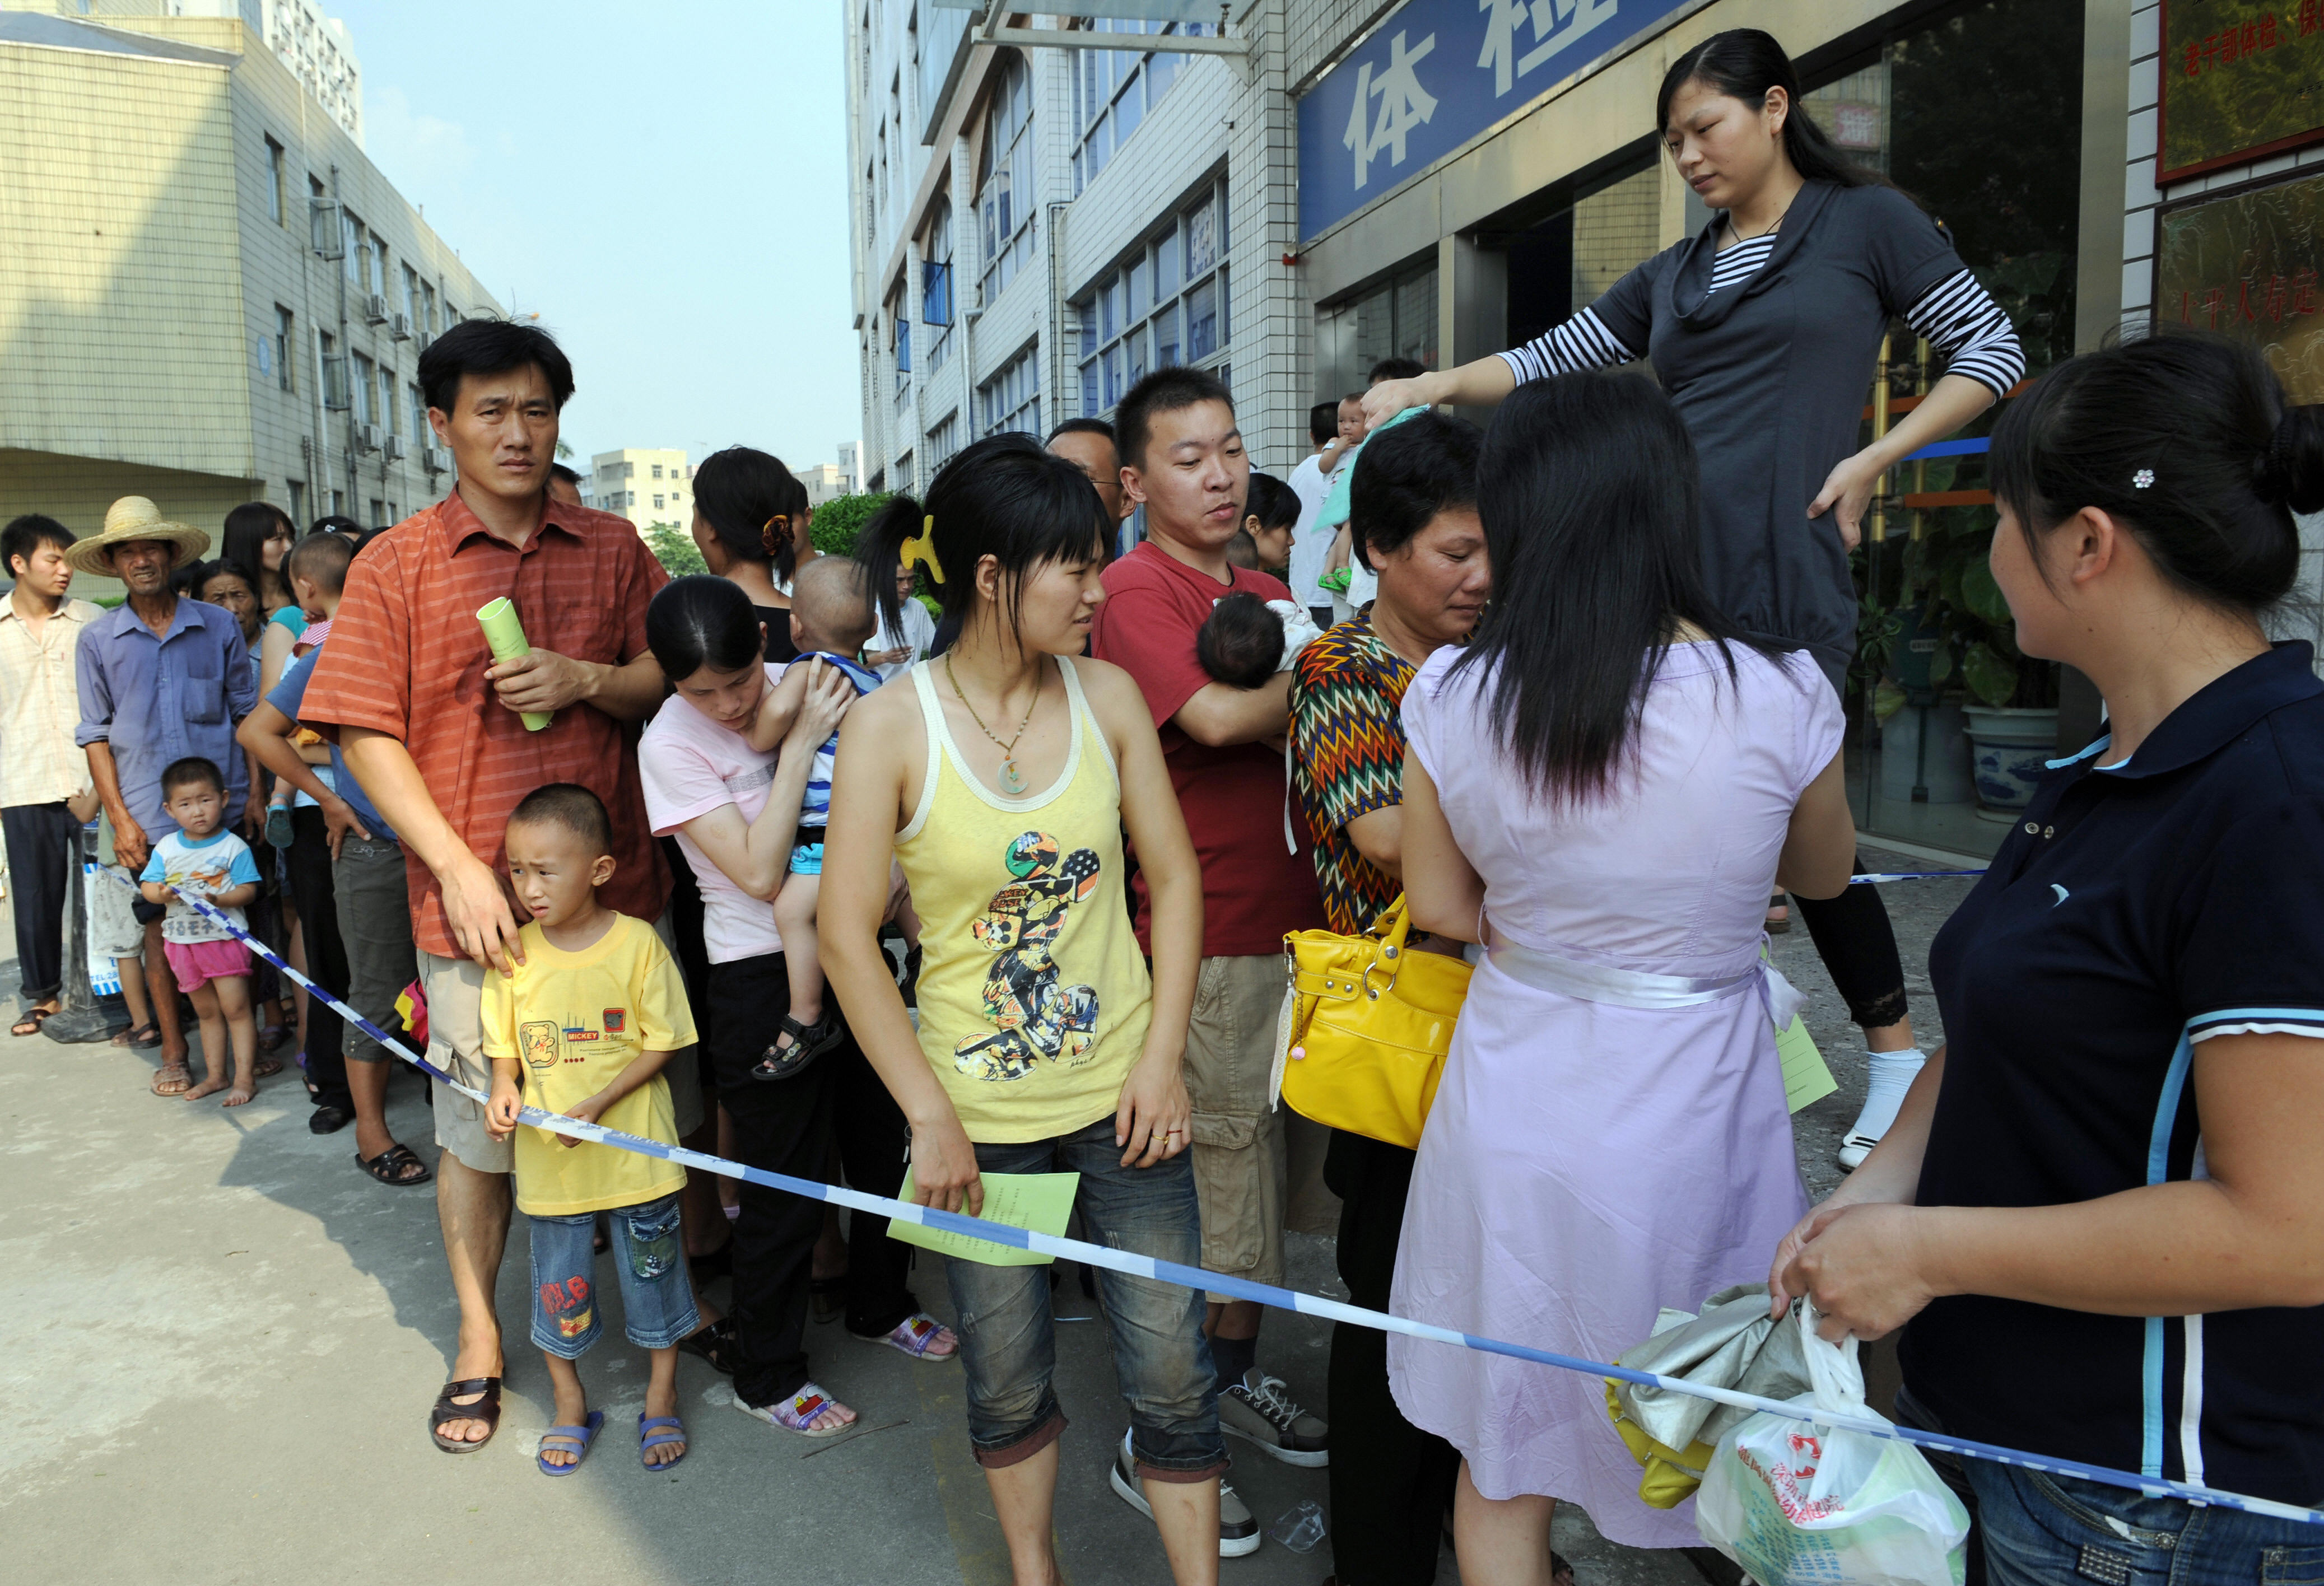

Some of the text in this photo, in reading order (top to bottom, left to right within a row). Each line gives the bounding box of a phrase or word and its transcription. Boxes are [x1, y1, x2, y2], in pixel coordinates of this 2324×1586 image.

[2185, 0, 2324, 77] 老干部体检、保
[567, 1032, 598, 1041] MICKEY
